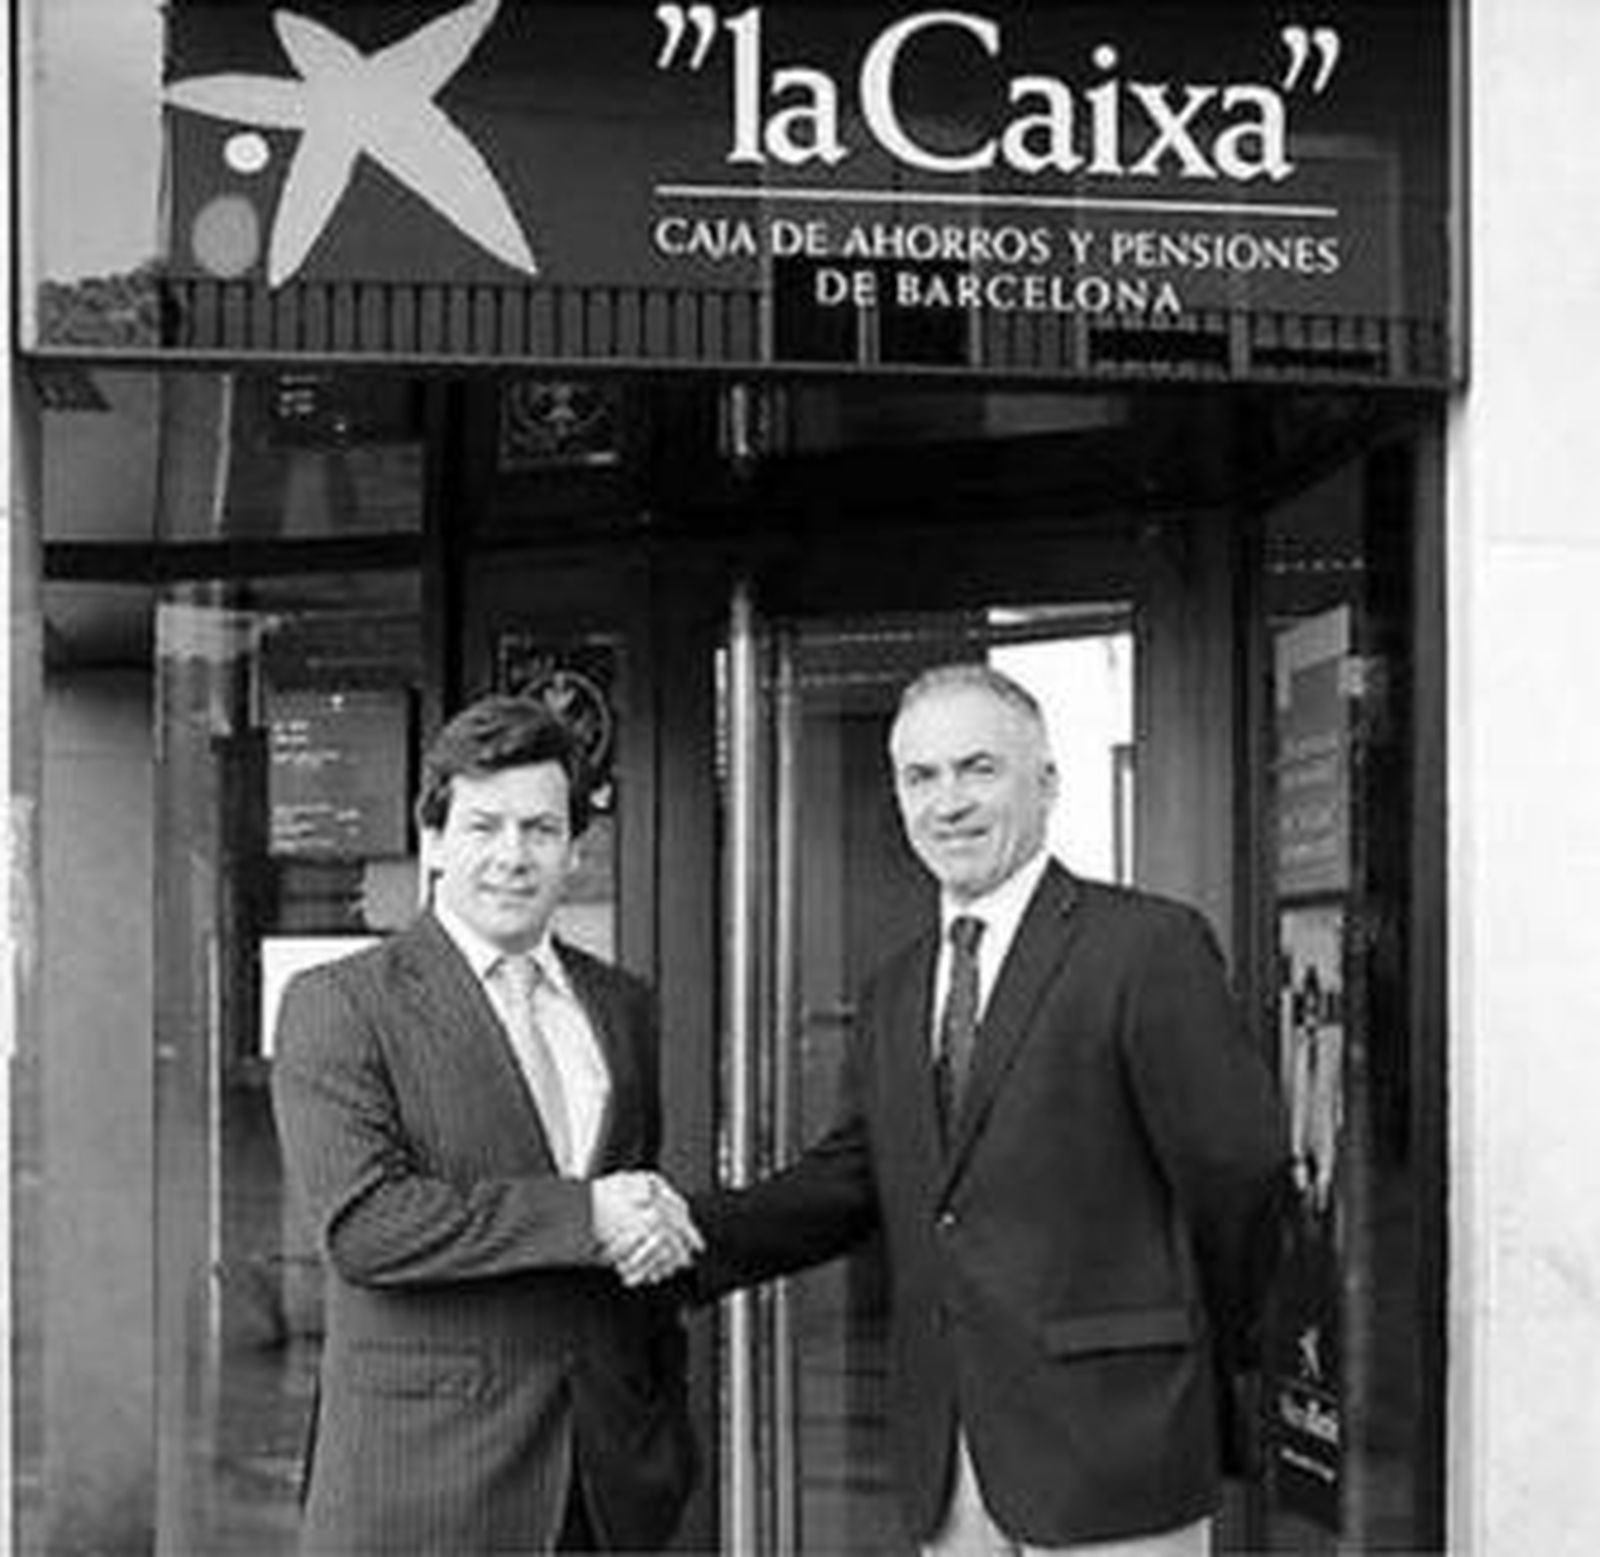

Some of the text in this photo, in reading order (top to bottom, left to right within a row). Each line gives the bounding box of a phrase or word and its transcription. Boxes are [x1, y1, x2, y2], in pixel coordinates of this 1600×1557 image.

[655, 218, 1340, 274] CAJA DE AHORROS Y PENSIONES
[815, 270, 1182, 316] DE BARCELONA
